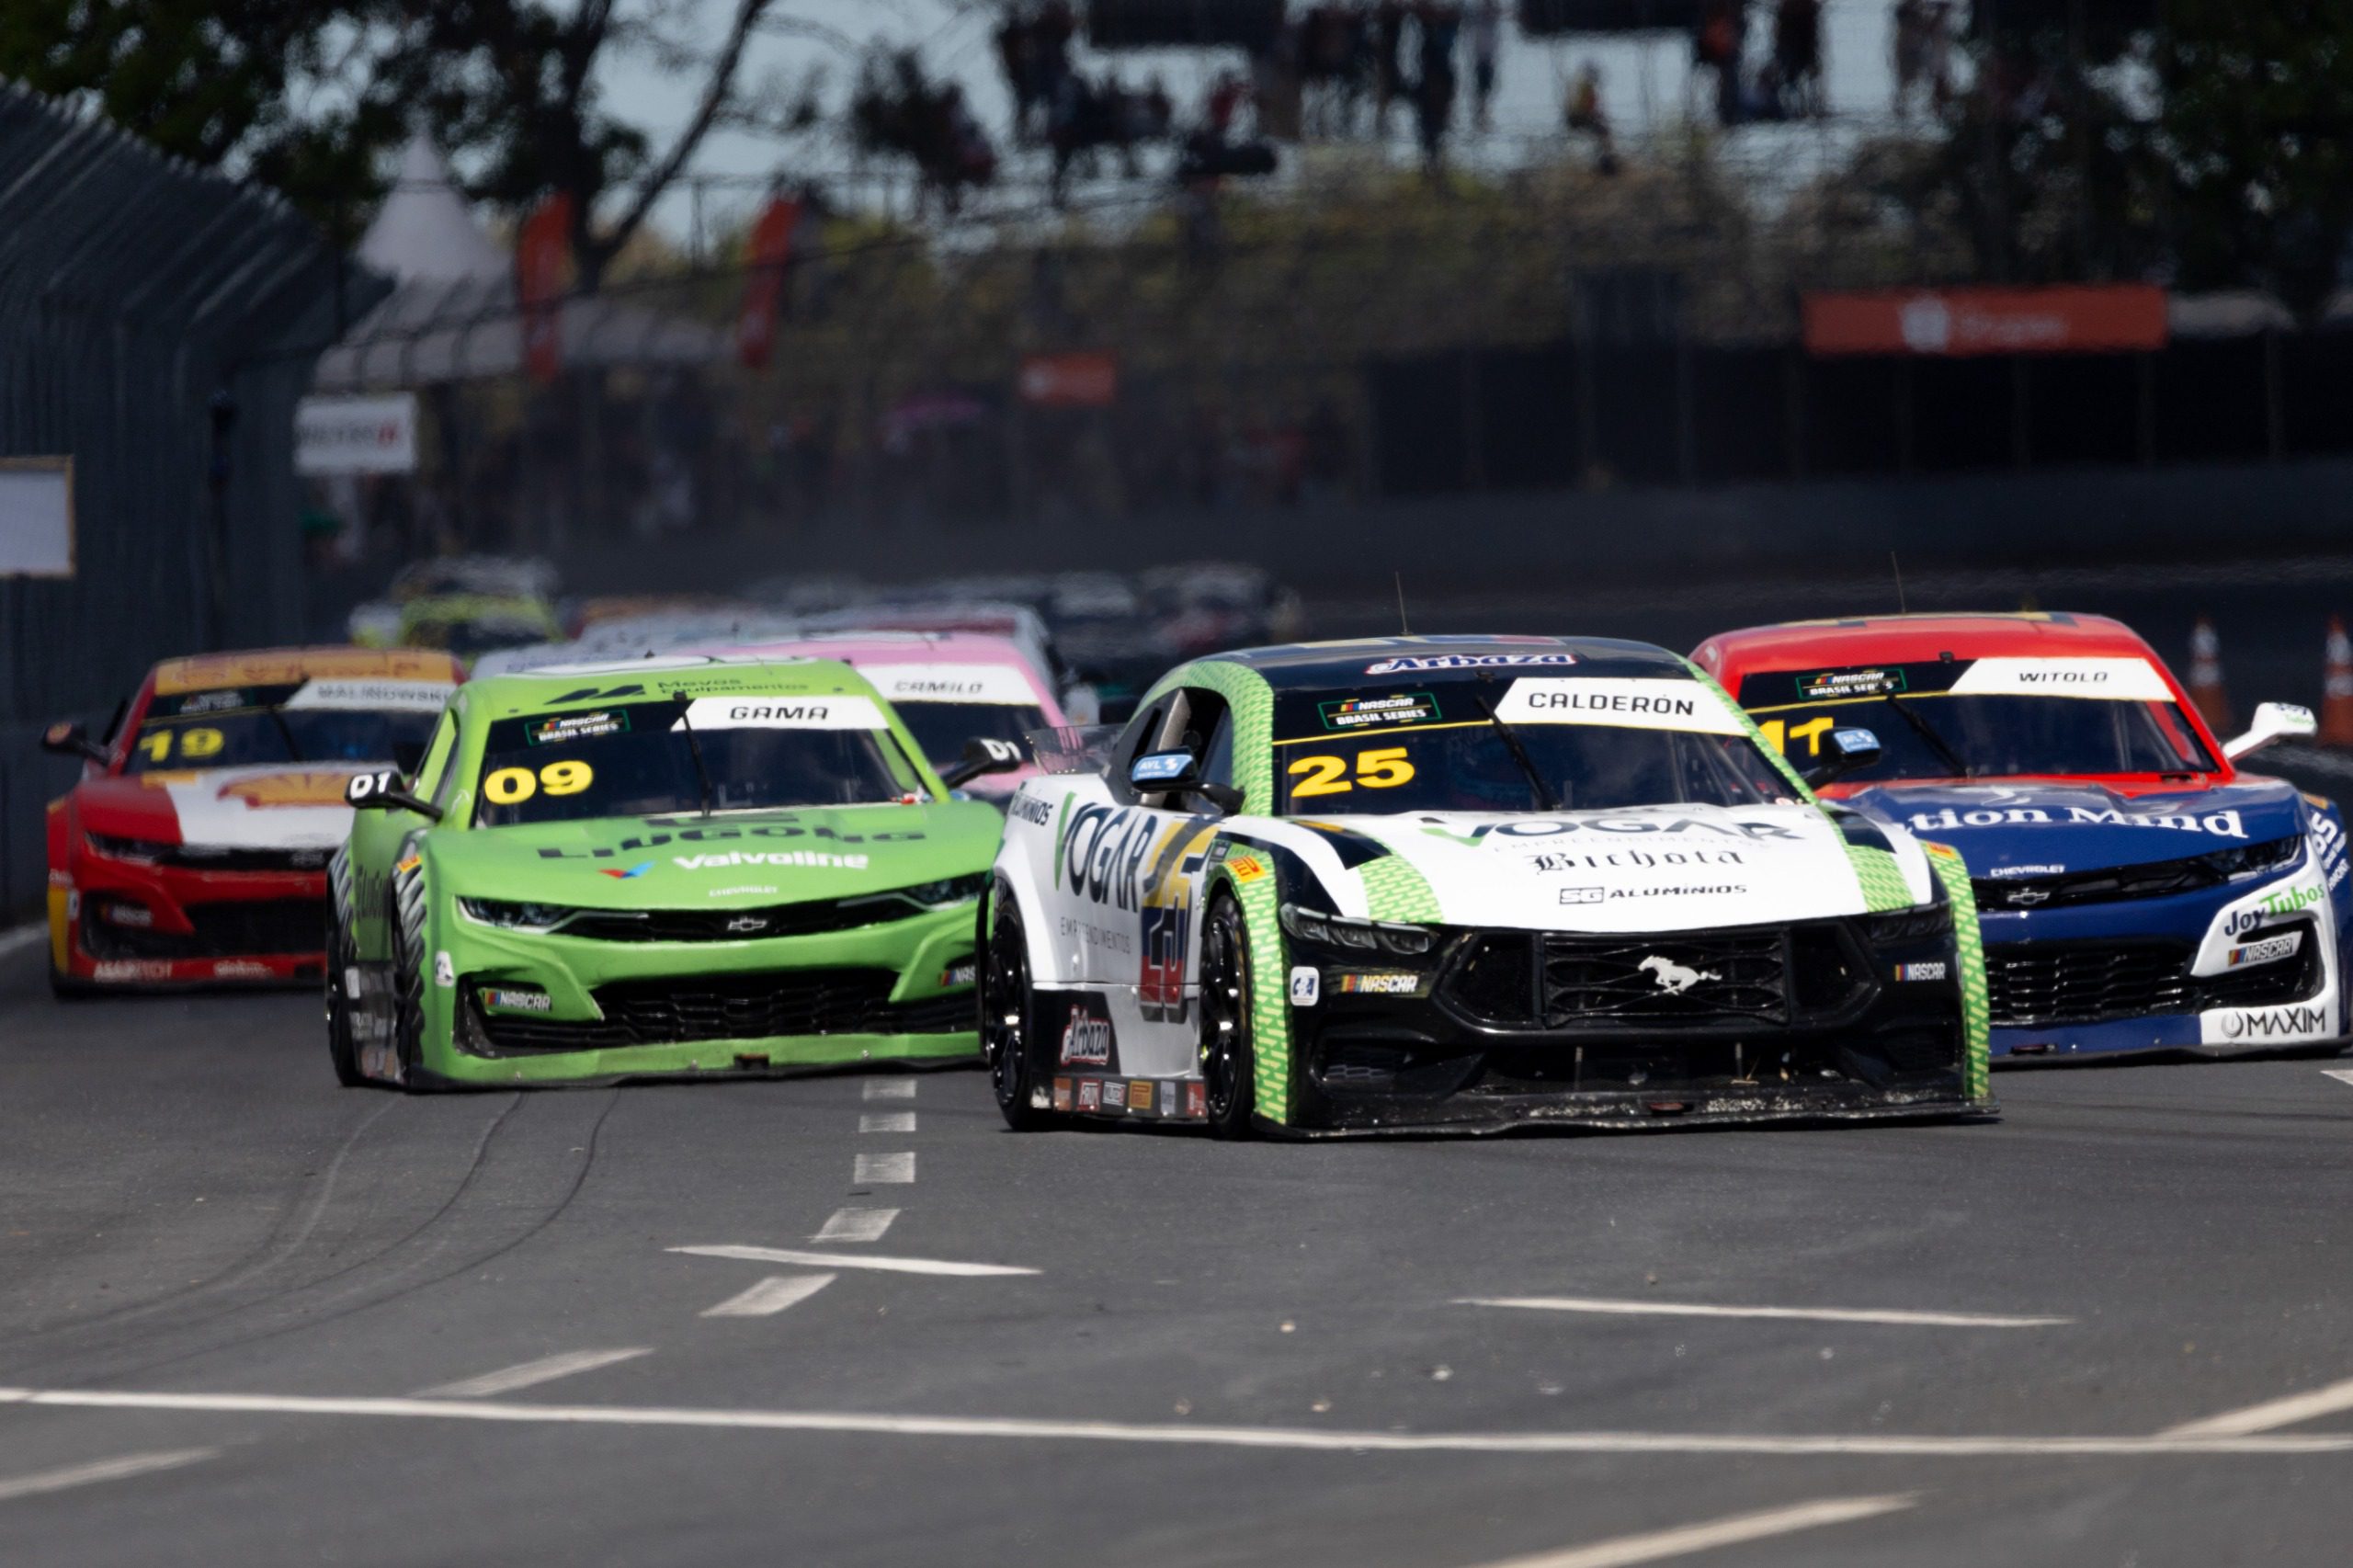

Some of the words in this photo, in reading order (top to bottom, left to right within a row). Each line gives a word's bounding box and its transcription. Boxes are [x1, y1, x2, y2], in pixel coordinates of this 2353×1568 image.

[1366, 653, 1576, 675] Arbaza
[1832, 673, 1883, 684] NASCAR
[1809, 686, 1850, 696] BRASIL
[1854, 682, 1893, 692] SERS
[730, 707, 828, 720] GAMA
[1358, 698, 1415, 710] NASCAR
[1529, 693, 1694, 716] CALDERÓN
[1336, 712, 1382, 725] BRASIL
[1382, 709, 1426, 721] SERIES
[140, 727, 224, 762] 19
[1288, 747, 1415, 797] 25
[350, 770, 391, 800] 01
[484, 760, 593, 804] 09
[1905, 808, 2052, 831] tion
[2068, 807, 2249, 838] Mind
[673, 850, 869, 869] Valvoline
[1991, 864, 2065, 877] CHEVROLET
[709, 885, 779, 897] CHEVROLET
[2245, 937, 2294, 962] NASCAR
[956, 965, 976, 984] NAS
[1907, 962, 1946, 981] NASCAR
[1360, 974, 1417, 993] NASCAR
[500, 992, 551, 1011] NASCAR
[2247, 1006, 2326, 1037] MAXIM
